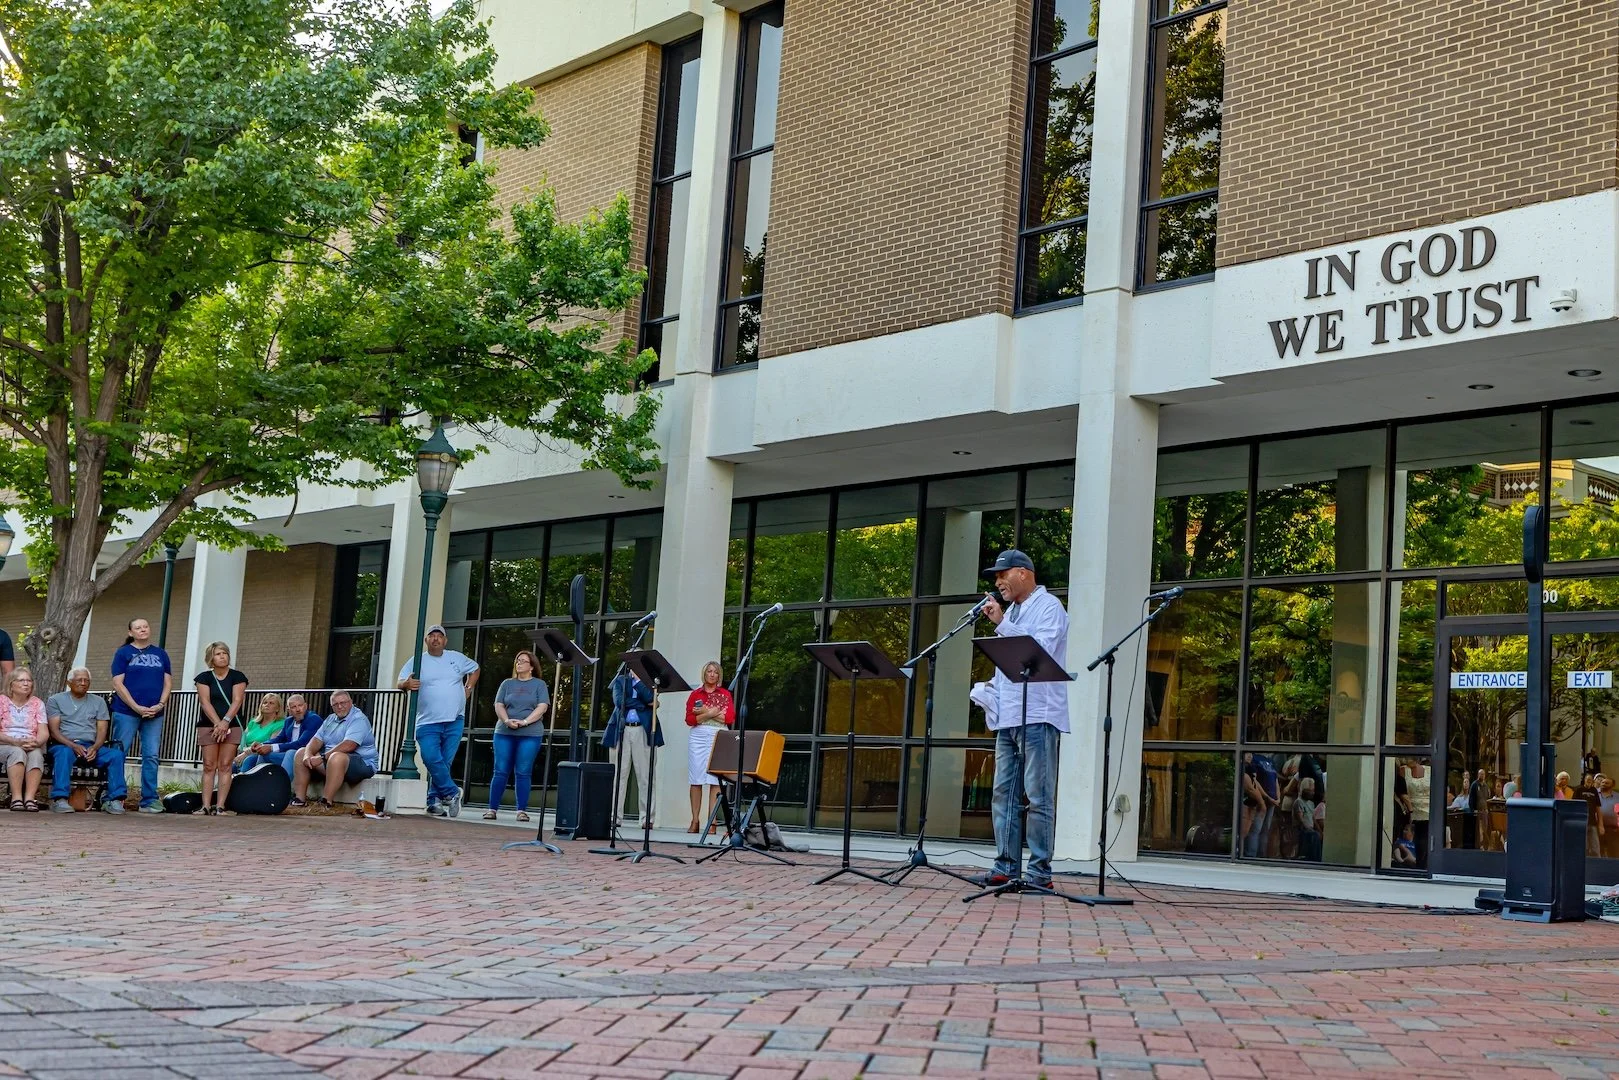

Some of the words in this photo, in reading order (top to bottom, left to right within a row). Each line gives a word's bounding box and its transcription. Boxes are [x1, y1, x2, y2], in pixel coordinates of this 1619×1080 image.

[1304, 250, 1360, 299] IN
[1380, 226, 1497, 284] GOD
[1267, 309, 1345, 359] WE
[1365, 275, 1540, 345] TRUST
[1458, 673, 1525, 687] ENTRANCE
[1574, 672, 1604, 687] EXIT
